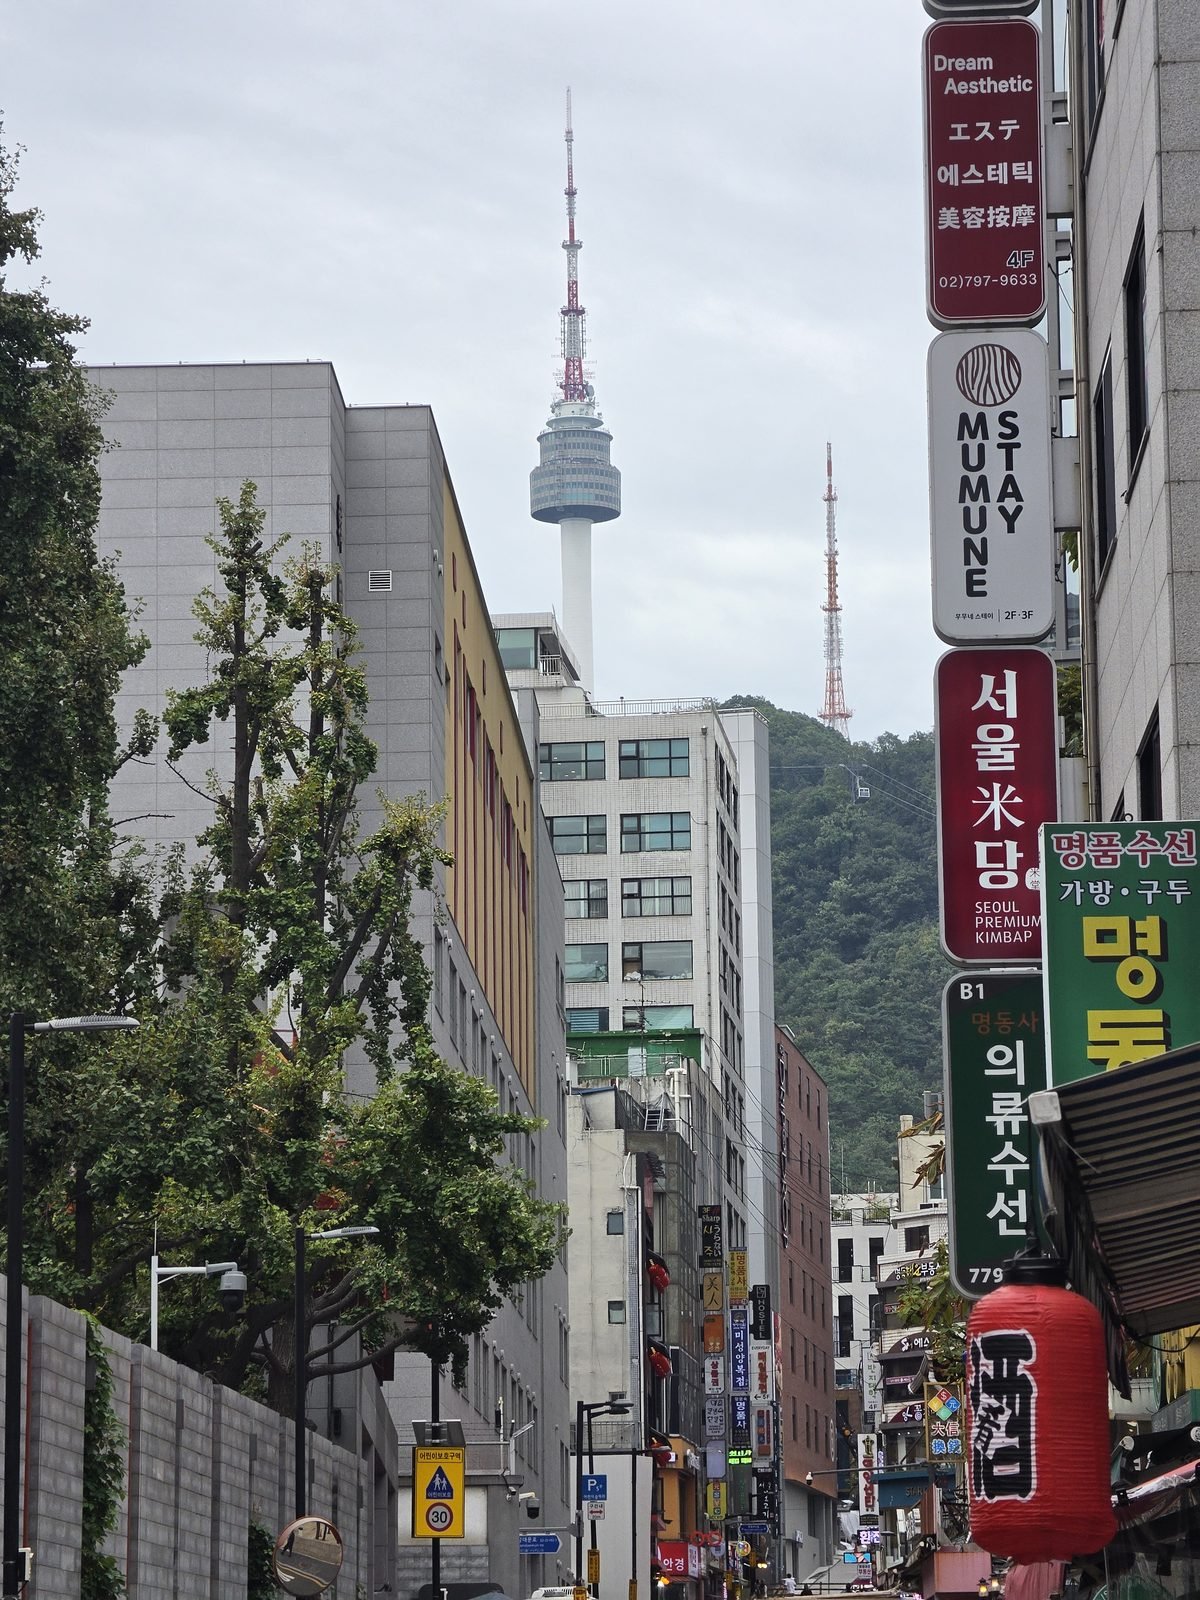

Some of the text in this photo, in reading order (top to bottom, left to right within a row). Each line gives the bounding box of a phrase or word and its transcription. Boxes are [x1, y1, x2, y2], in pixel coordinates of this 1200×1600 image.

[934, 54, 993, 72] Dream
[944, 75, 1033, 95] Aesthetic
[949, 119, 1020, 141] エステ
[937, 161, 1033, 186] 에스테틱
[938, 204, 1036, 229] 美容按摩
[1006, 250, 1035, 269] 4F
[939, 274, 1037, 289] 02)797-9633
[996, 410, 1024, 534] STAY
[957, 411, 991, 598] MUMUNE
[975, 611, 994, 620] 스테이
[971, 669, 1025, 889] 서울米당
[1050, 829, 1198, 870] 명품수선
[975, 901, 1020, 914] SEOUL
[975, 915, 1041, 929] PREMIUM
[975, 931, 1033, 944] KIMBAP
[960, 983, 984, 1000] B1
[971, 1011, 1039, 1035] 명동사
[984, 1039, 1030, 1236] 의류수선
[969, 1267, 1004, 1284] 779
[735, 1330, 746, 1387] 미성양복점
[736, 1401, 746, 1429] 명품사
[931, 1421, 960, 1437] 大信
[420, 1452, 461, 1460] 어린이보호구역
[588, 1479, 597, 1492] P
[431, 1511, 448, 1523] 30
[663, 1558, 684, 1572] 안경
